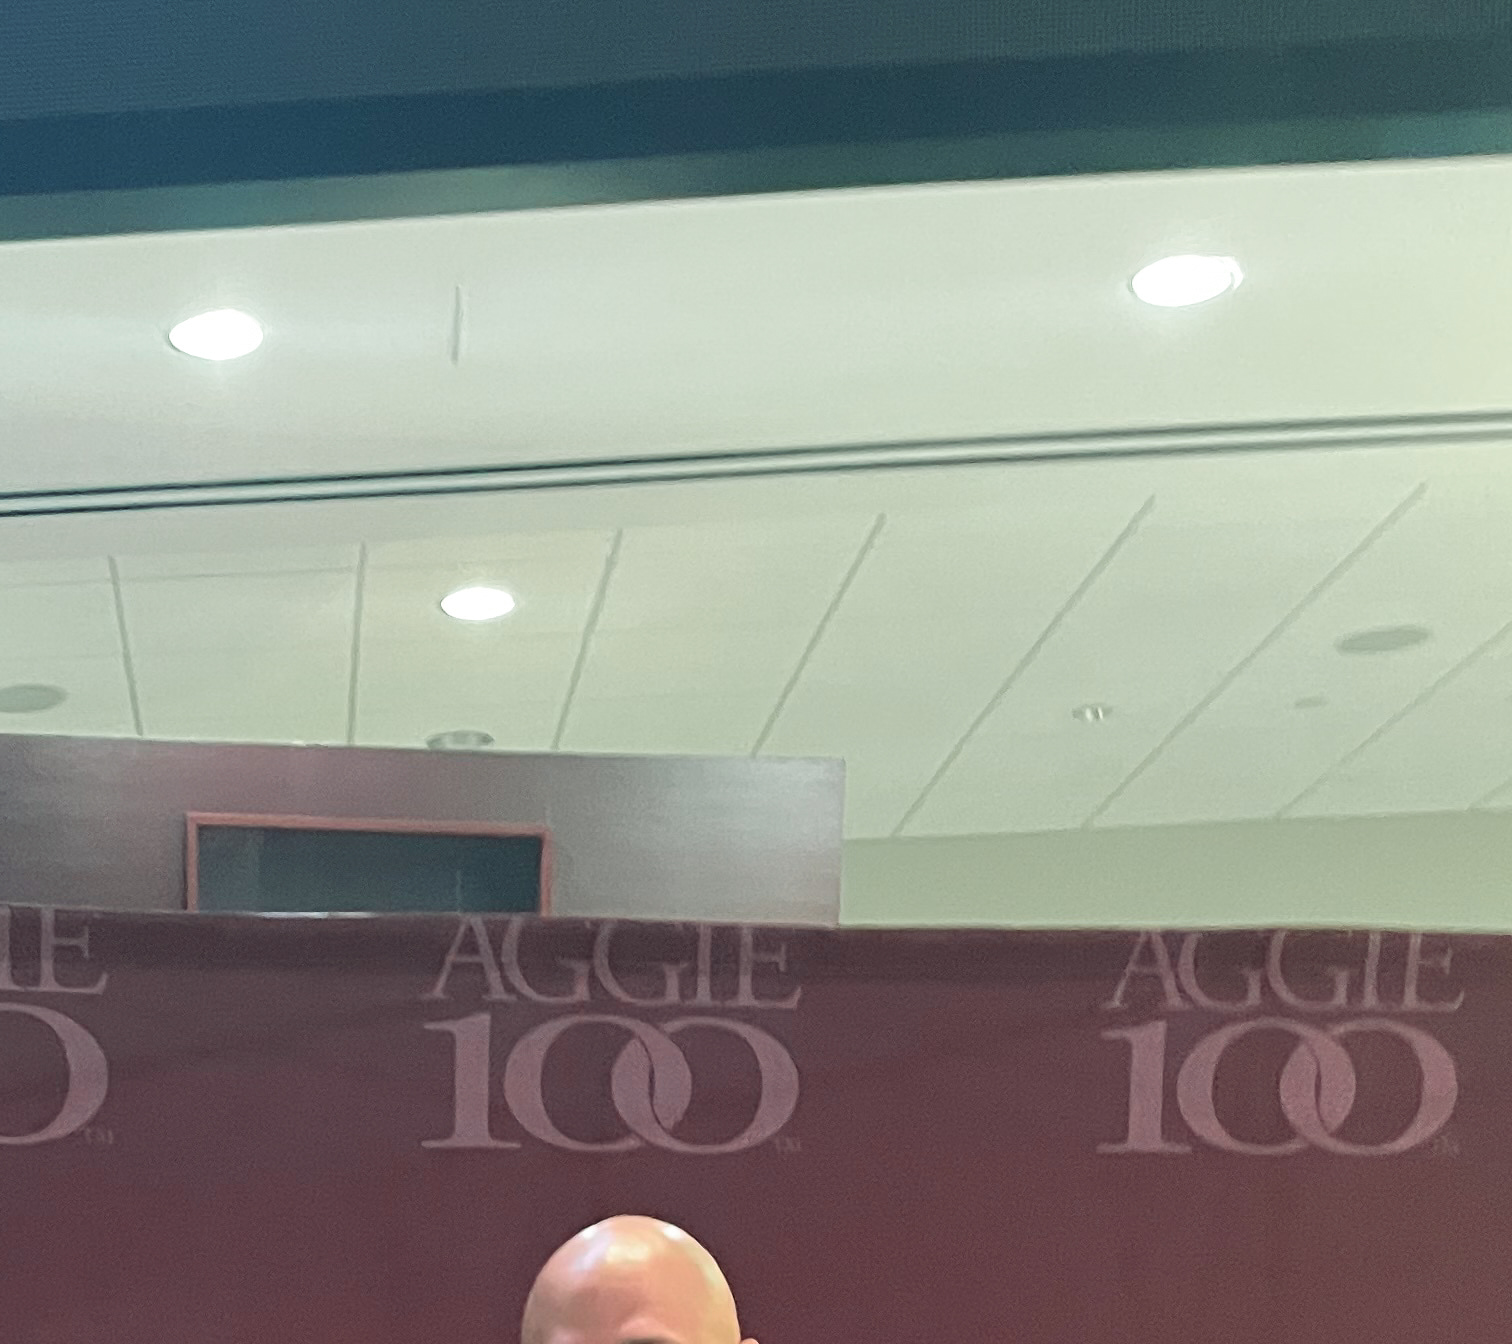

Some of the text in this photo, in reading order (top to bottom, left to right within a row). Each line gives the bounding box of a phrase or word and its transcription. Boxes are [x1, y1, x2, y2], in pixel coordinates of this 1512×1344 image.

[424, 915, 802, 1009] AGGIE
[1100, 930, 1464, 1013] AGGIE
[421, 1012, 800, 1155] 100
[1096, 1016, 1458, 1156] 100
